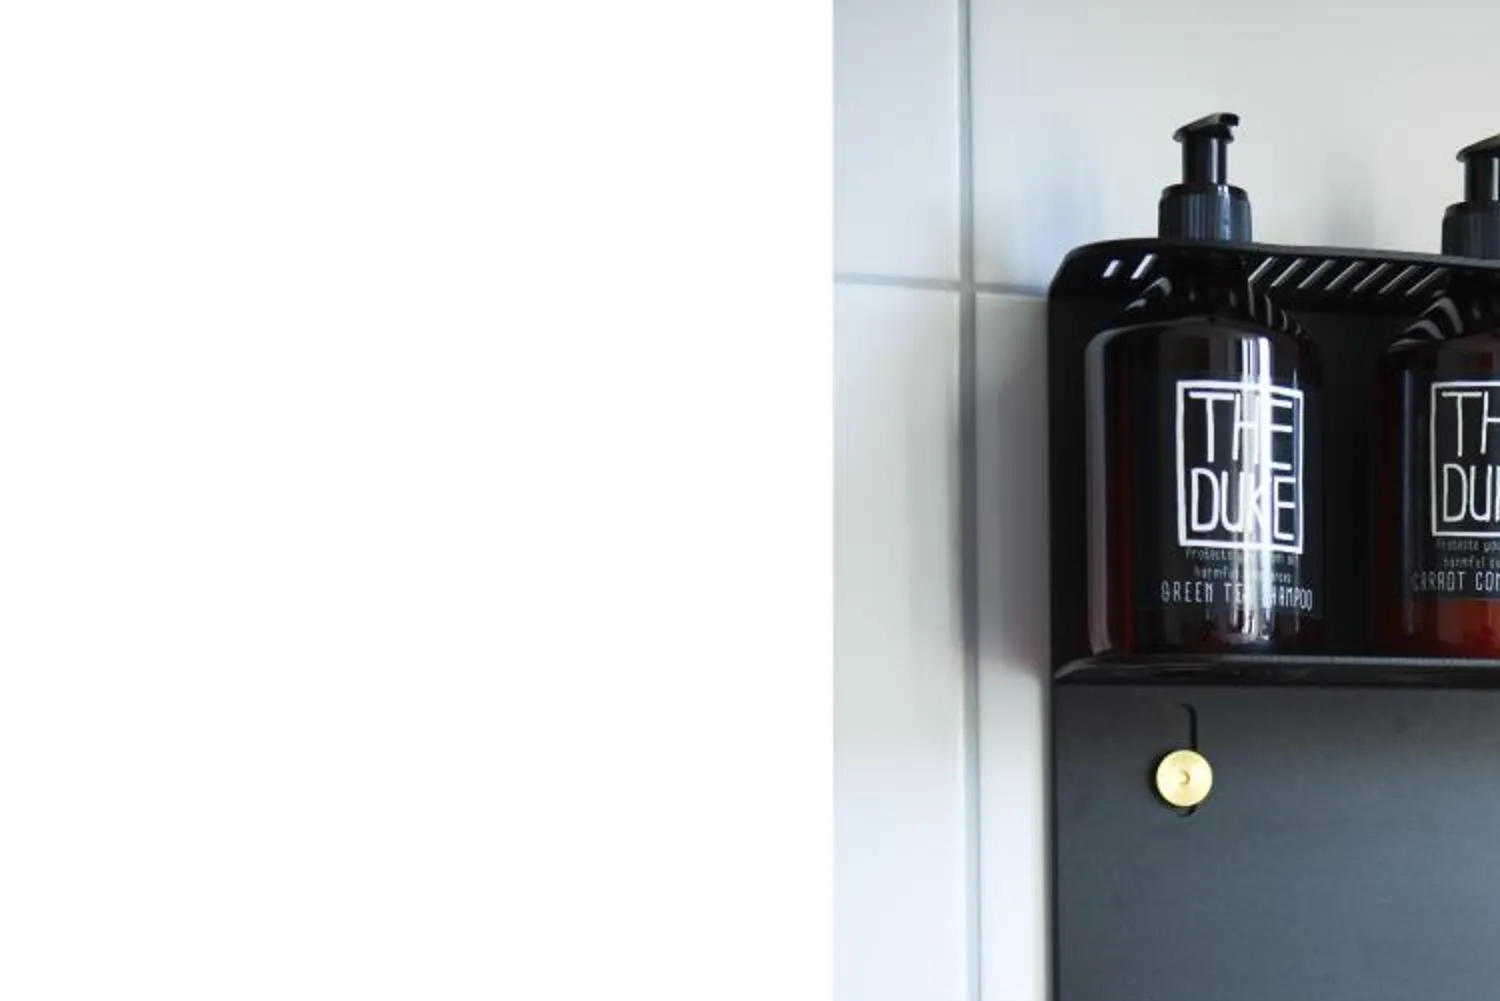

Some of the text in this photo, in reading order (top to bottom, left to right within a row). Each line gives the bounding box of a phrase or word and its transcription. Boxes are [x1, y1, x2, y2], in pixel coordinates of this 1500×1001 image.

[1188, 391, 1293, 471] THE
[1190, 467, 1296, 541] DUKE
[1161, 580, 1313, 611] GREEN TE HAMPOO
